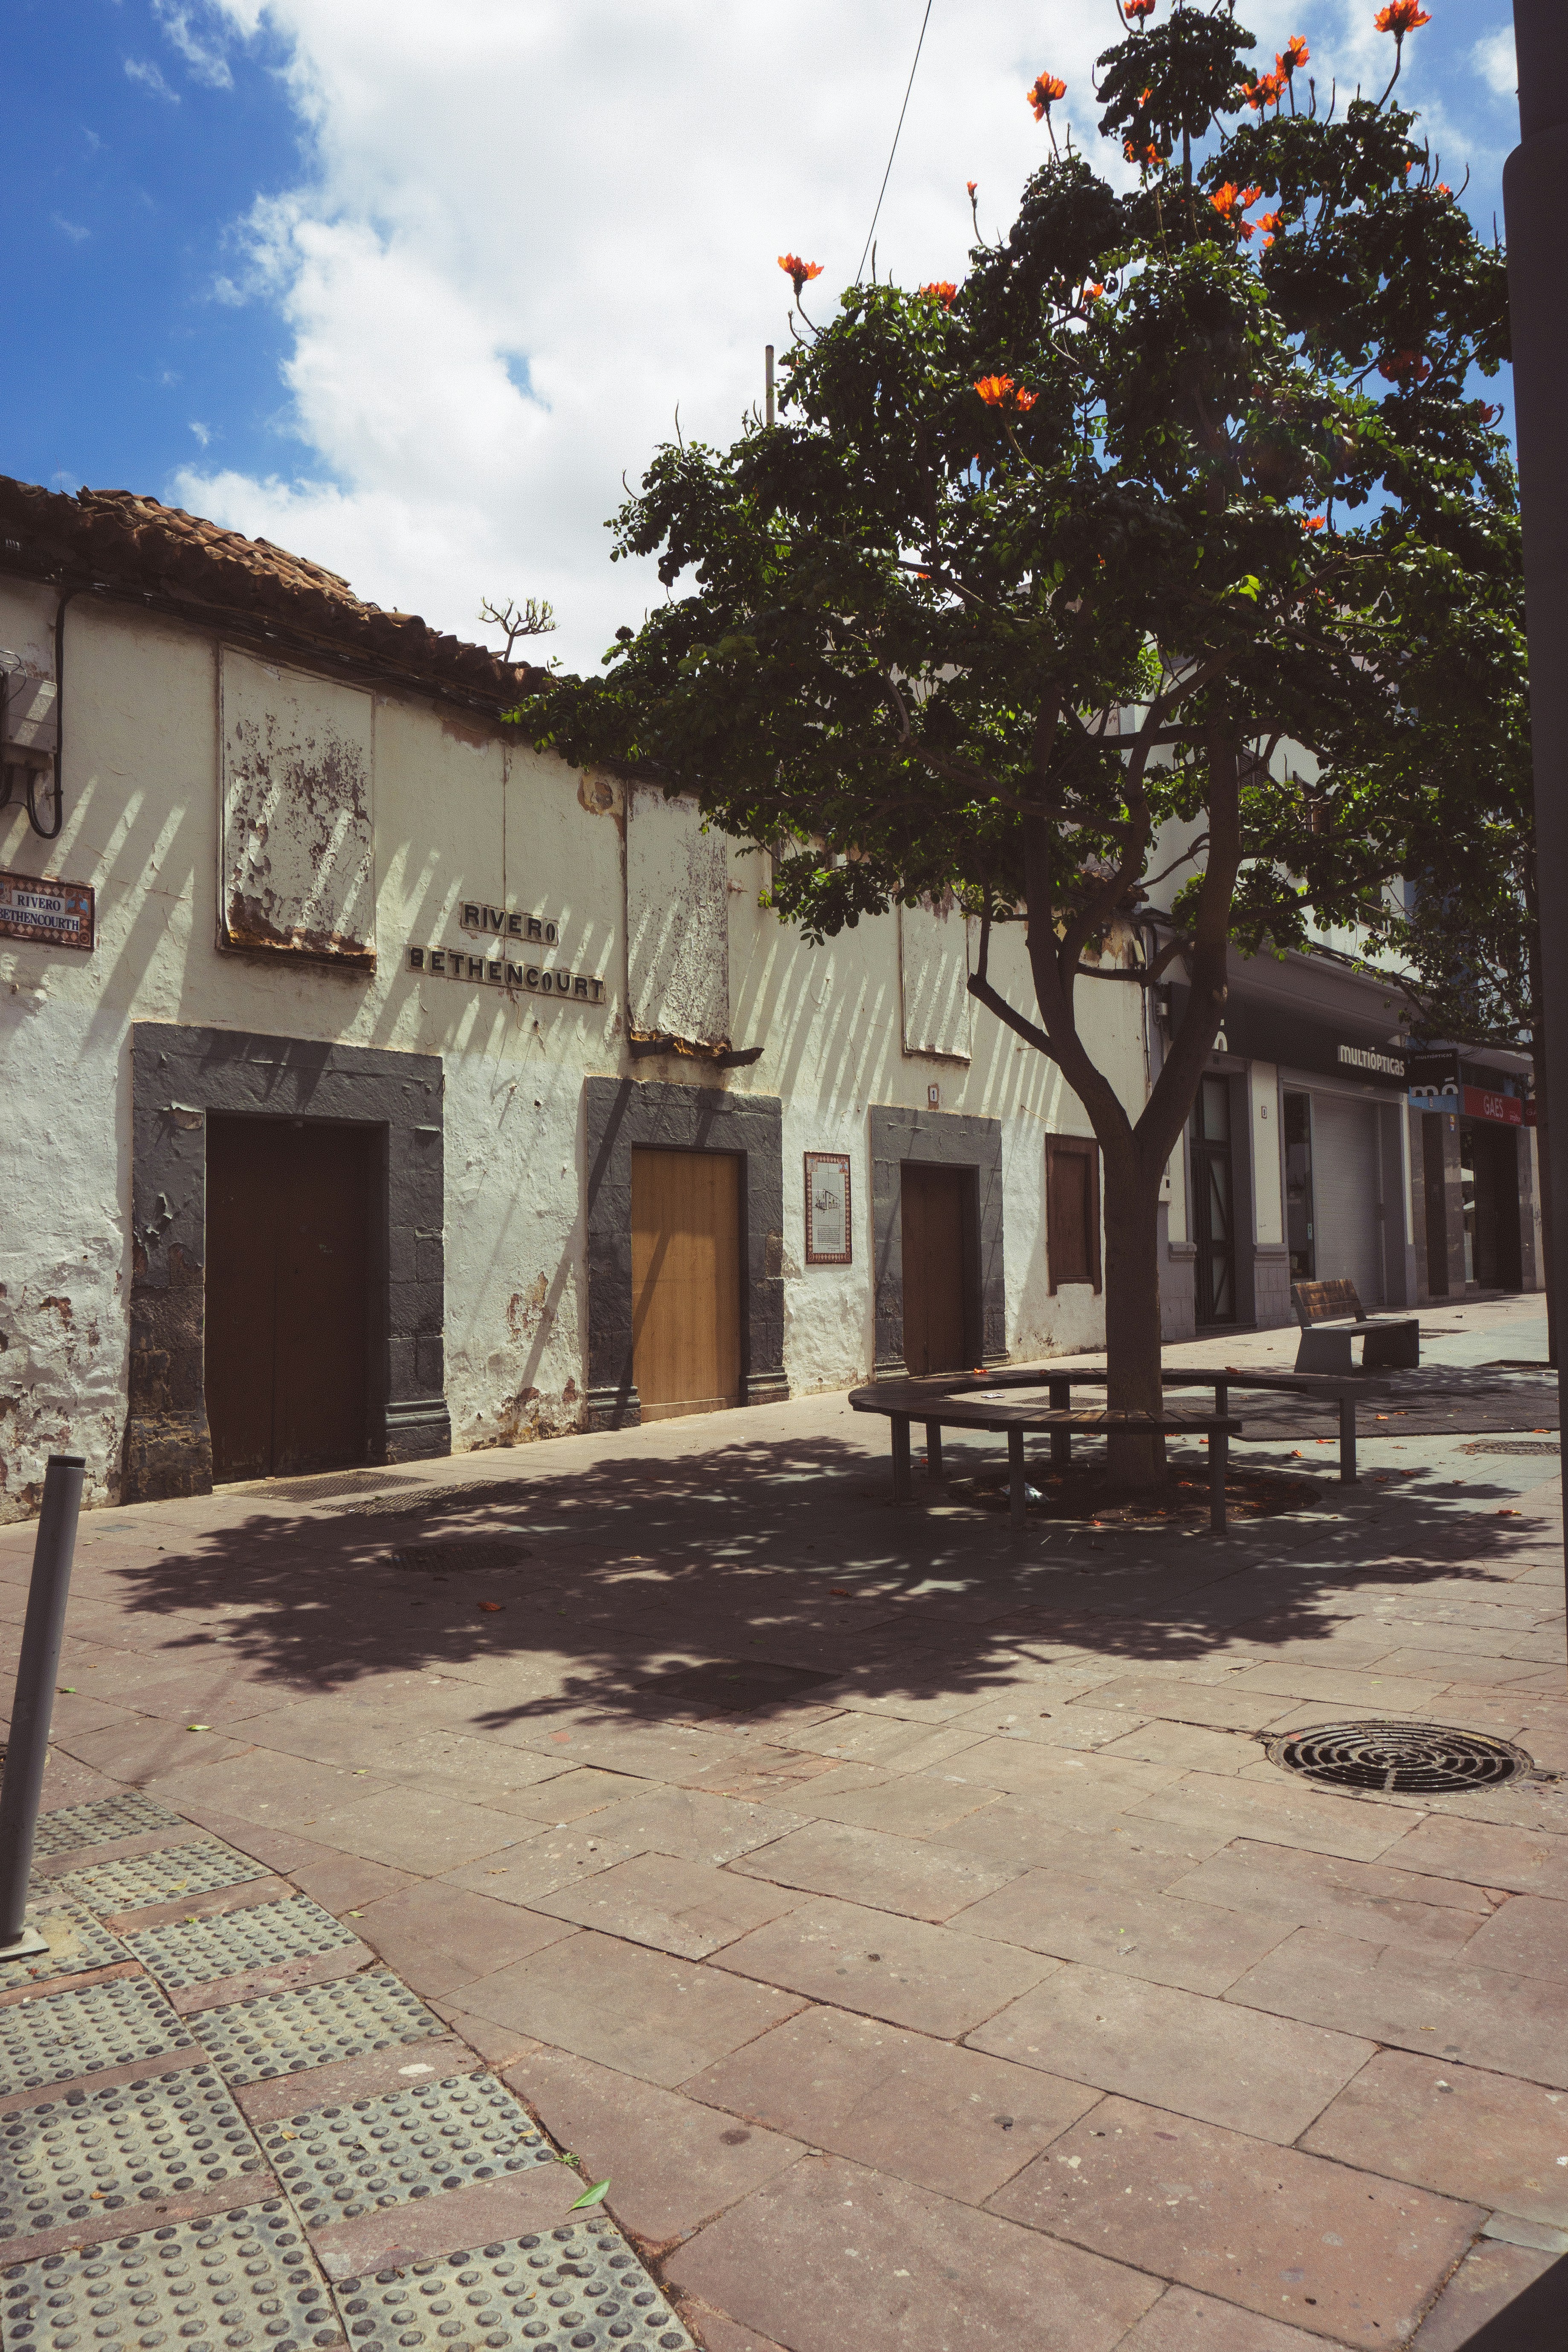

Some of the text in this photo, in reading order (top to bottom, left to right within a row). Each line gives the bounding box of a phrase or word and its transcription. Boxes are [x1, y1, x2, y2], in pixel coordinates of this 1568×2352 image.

[17, 895, 61, 911] RIVERO
[464, 904, 556, 941] RIVERO
[410, 947, 604, 998] BETHENCOURT
[1484, 1095, 1504, 1118] GAES
